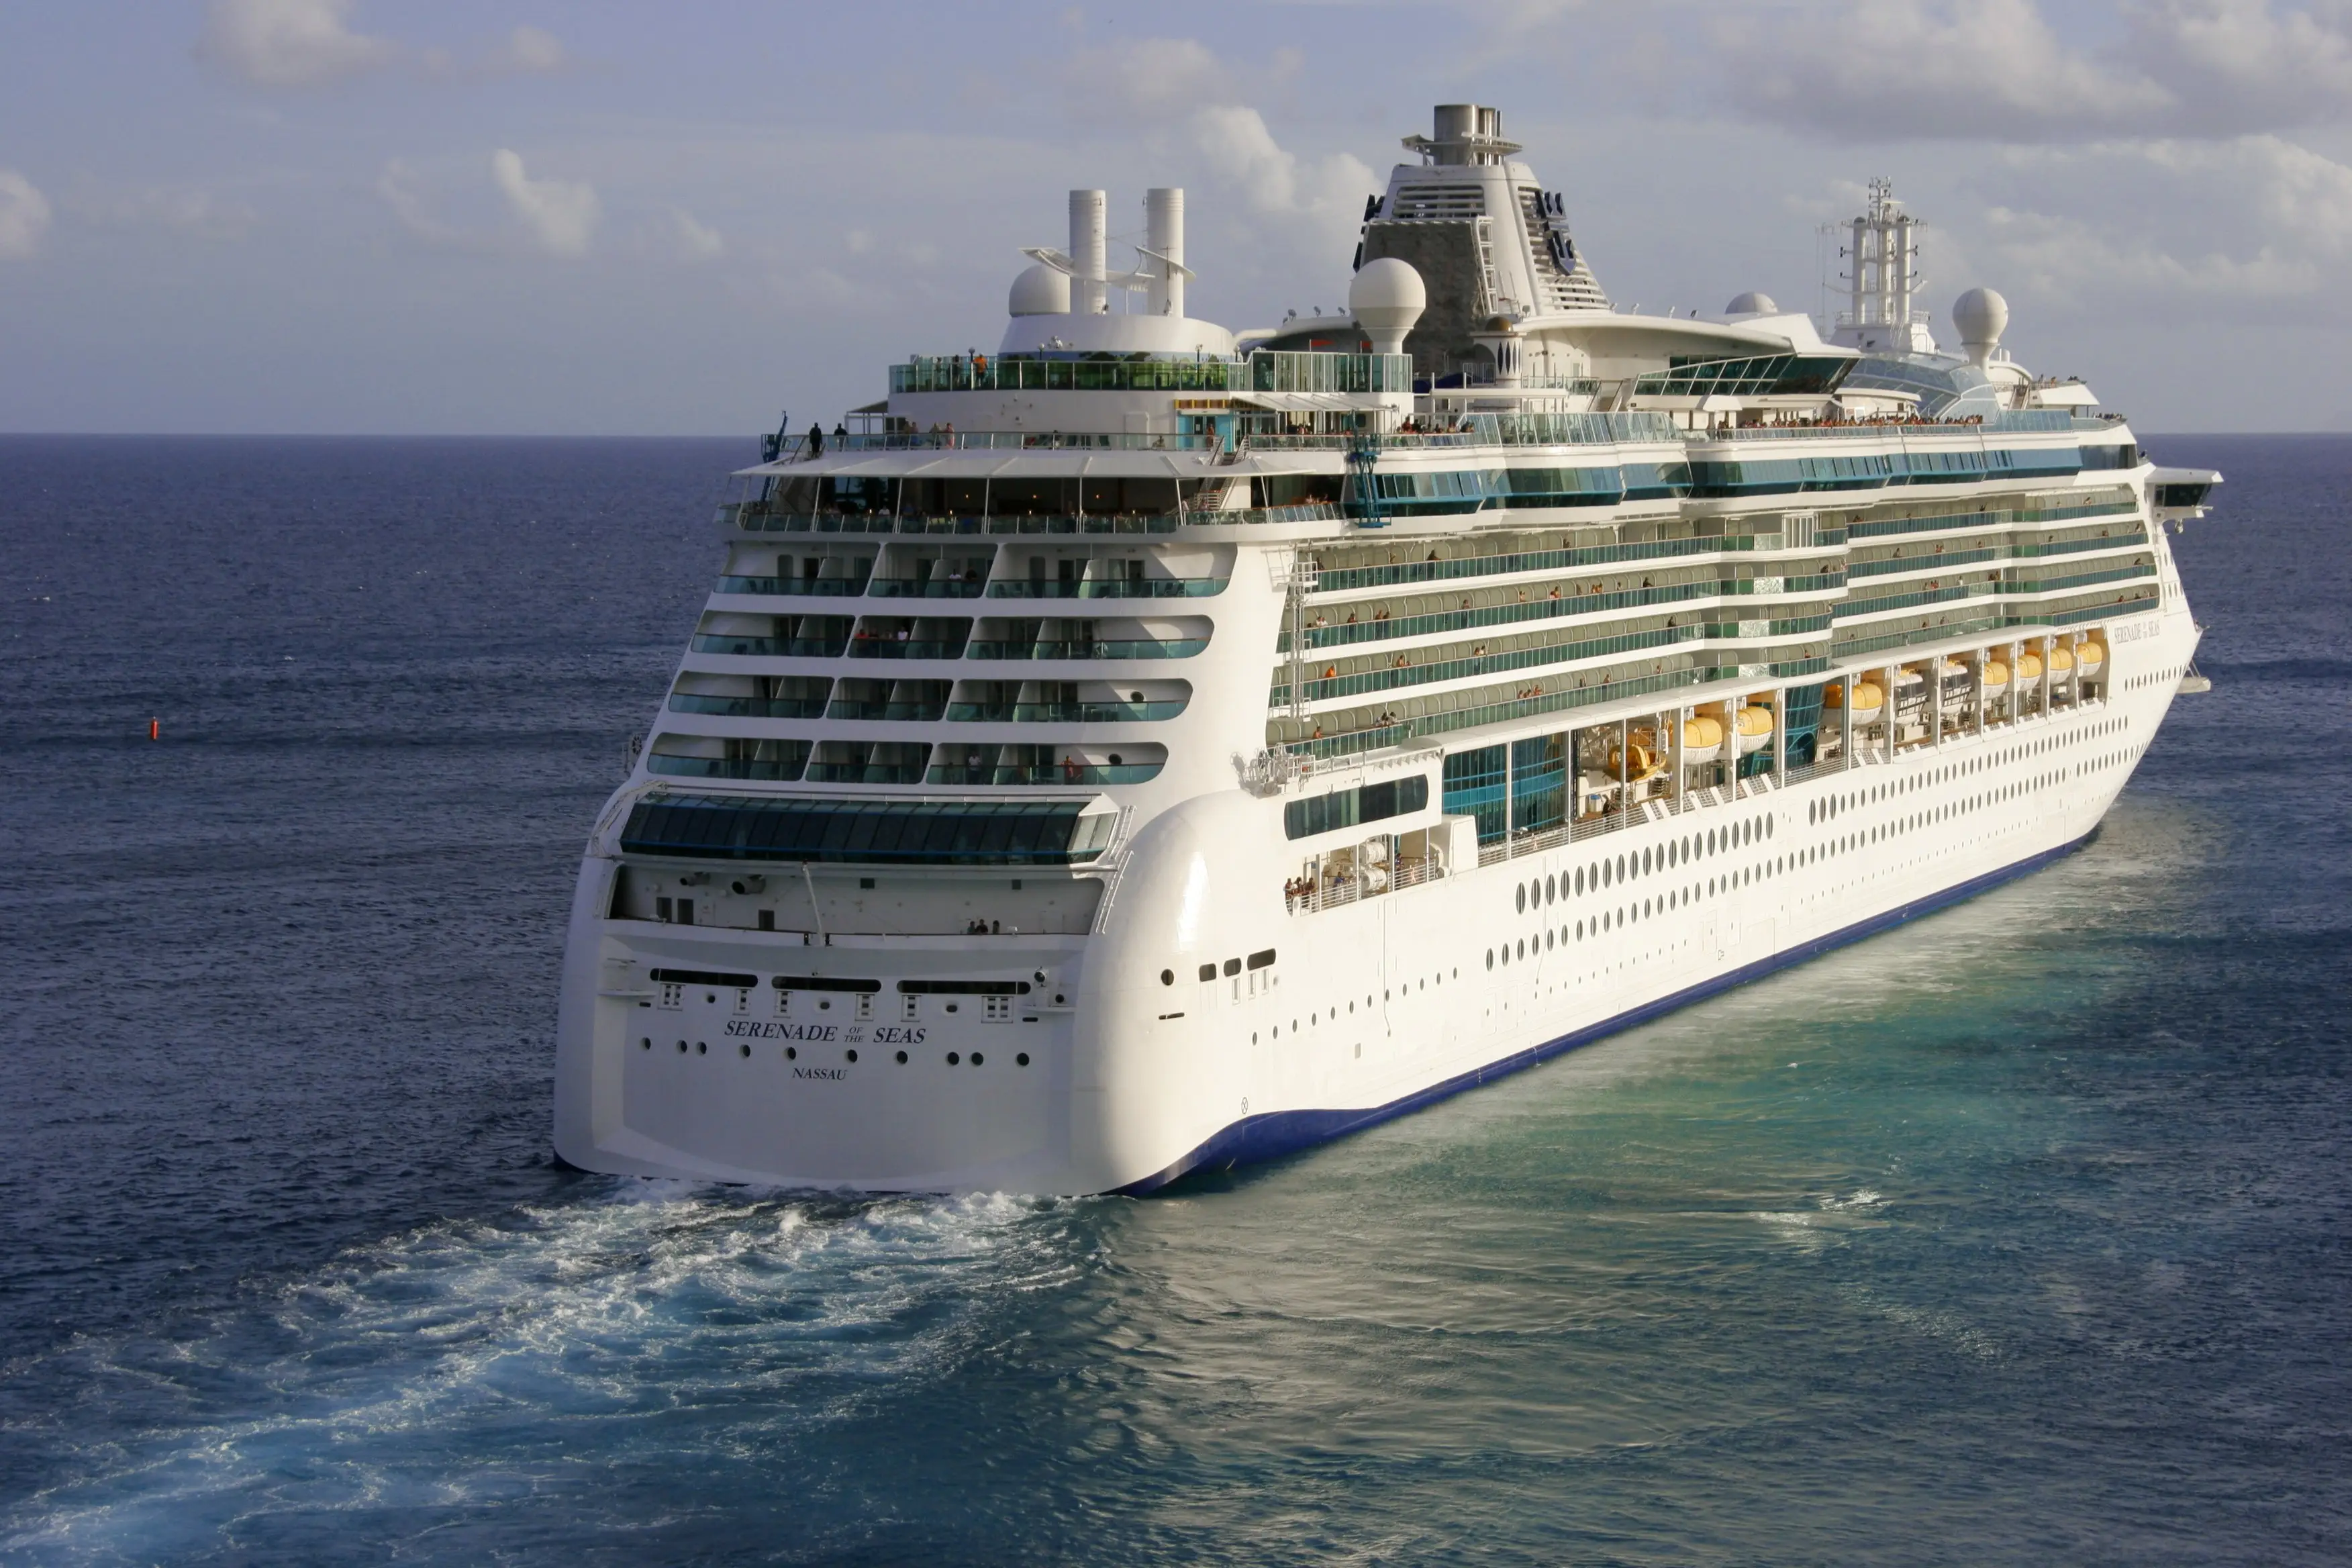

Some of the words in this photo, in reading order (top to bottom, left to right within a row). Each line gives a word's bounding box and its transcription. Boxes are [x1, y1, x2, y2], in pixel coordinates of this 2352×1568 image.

[724, 1020, 838, 1041] SERENADE
[849, 1026, 864, 1034] OF
[873, 1027, 926, 1044] SEAS
[793, 1067, 847, 1081] NASSAU
